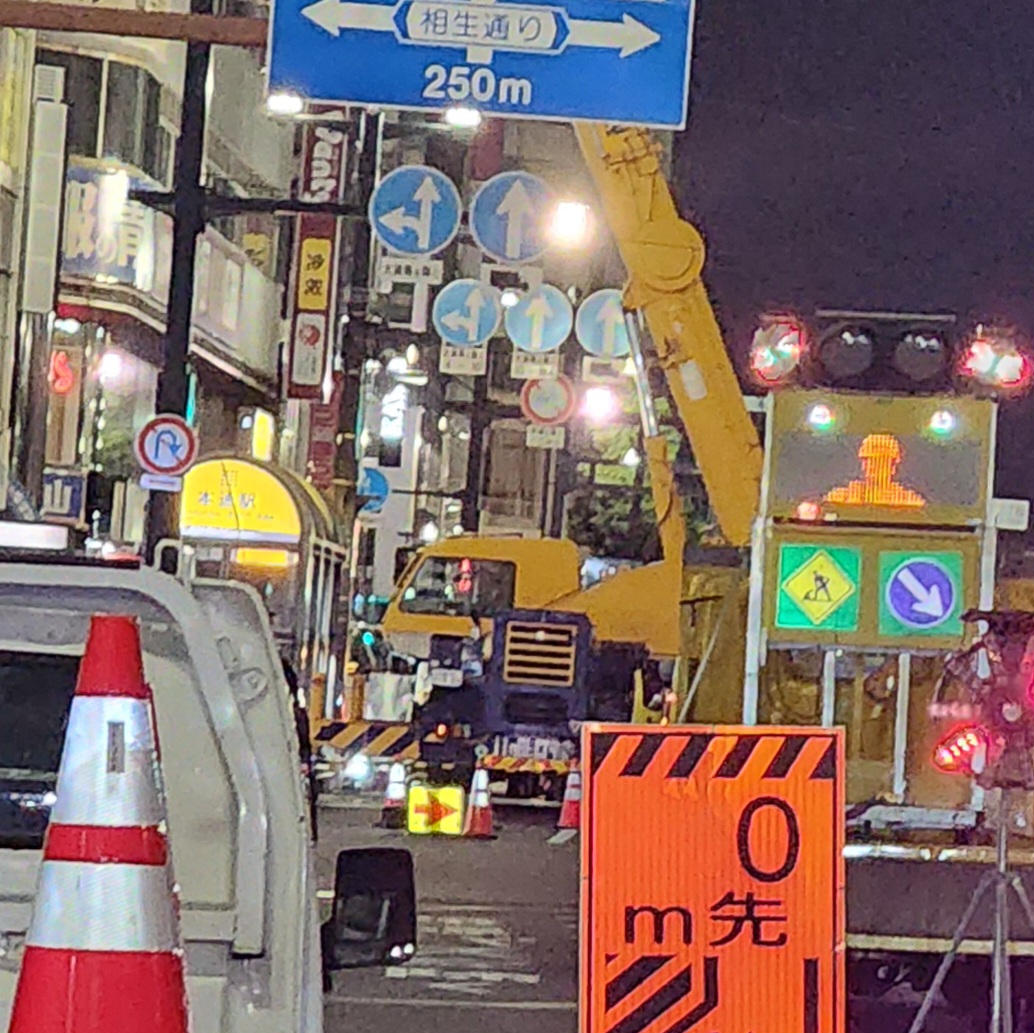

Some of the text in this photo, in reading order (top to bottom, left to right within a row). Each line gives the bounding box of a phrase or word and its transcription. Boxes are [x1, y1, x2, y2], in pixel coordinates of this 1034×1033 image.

[420, 8, 541, 42] 相生通り
[737, 796, 800, 883] 0
